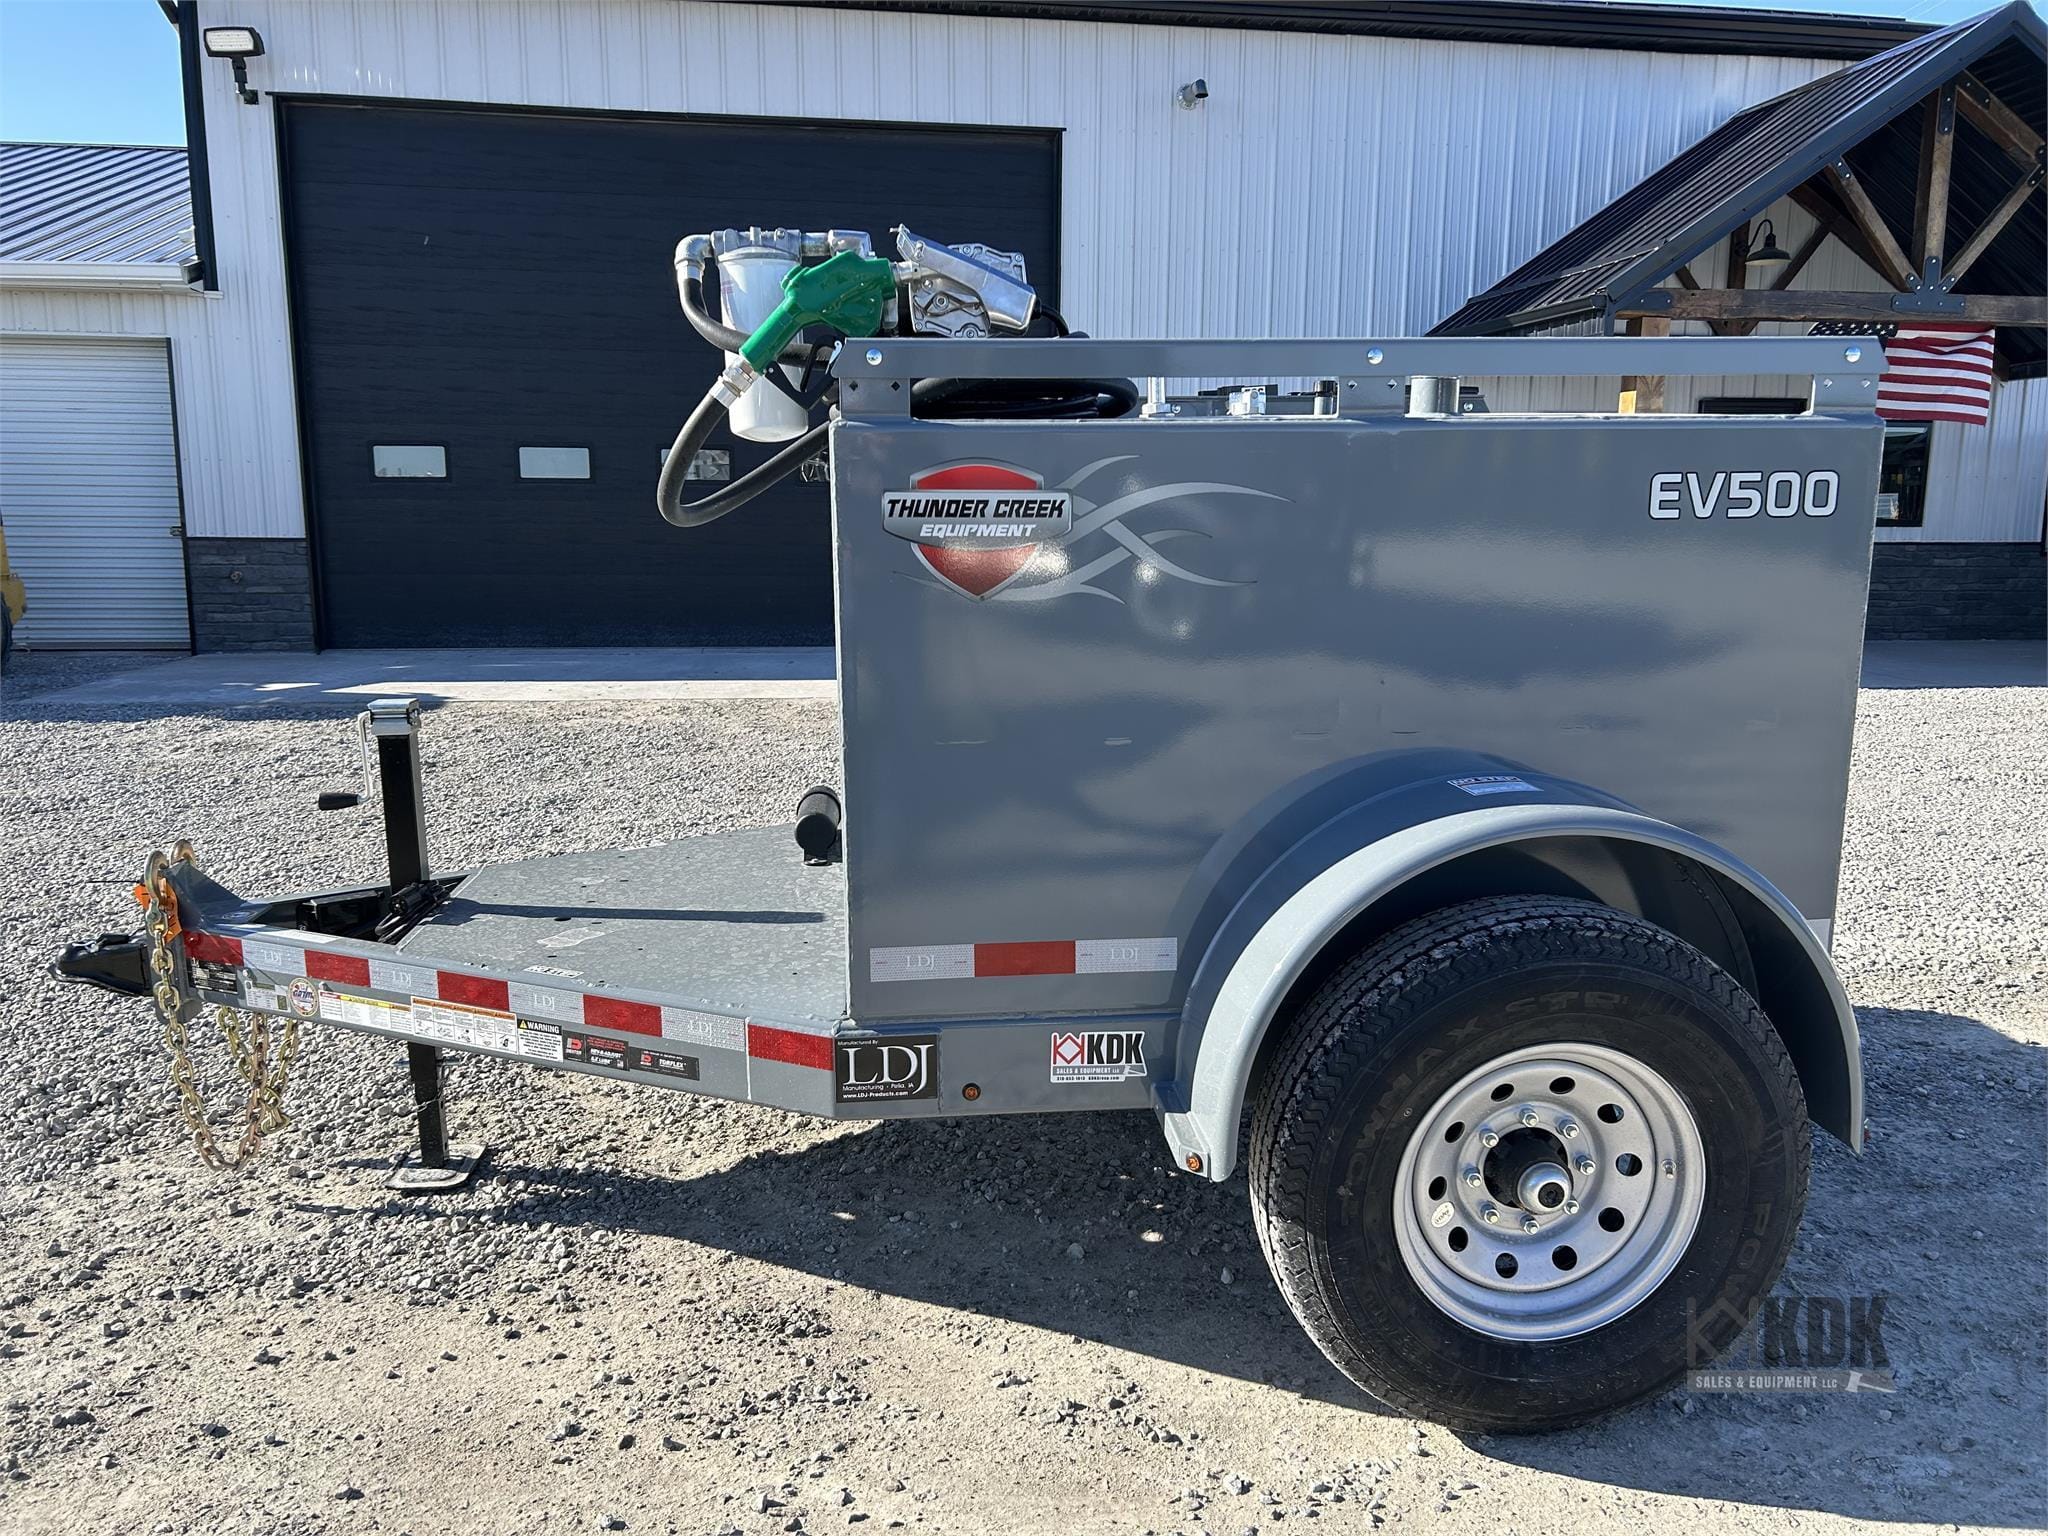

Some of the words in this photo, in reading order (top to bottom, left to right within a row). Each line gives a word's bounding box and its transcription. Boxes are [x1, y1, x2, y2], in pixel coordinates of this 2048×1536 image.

[1649, 470, 1839, 519] EV500
[887, 499, 990, 519] THUNDER
[992, 499, 1066, 519] CREEK
[919, 523, 1037, 539] EQUIPMENT
[527, 1020, 560, 1034] WARNING
[1086, 1033, 1143, 1065] KDK
[841, 1044, 935, 1095] LDJ
[1056, 1067, 1074, 1075] SALES
[1080, 1066, 1111, 1074] EQUIPMENT
[842, 1084, 885, 1092] Manufacturing
[842, 1091, 909, 1099] www.LDJ-Products.com
